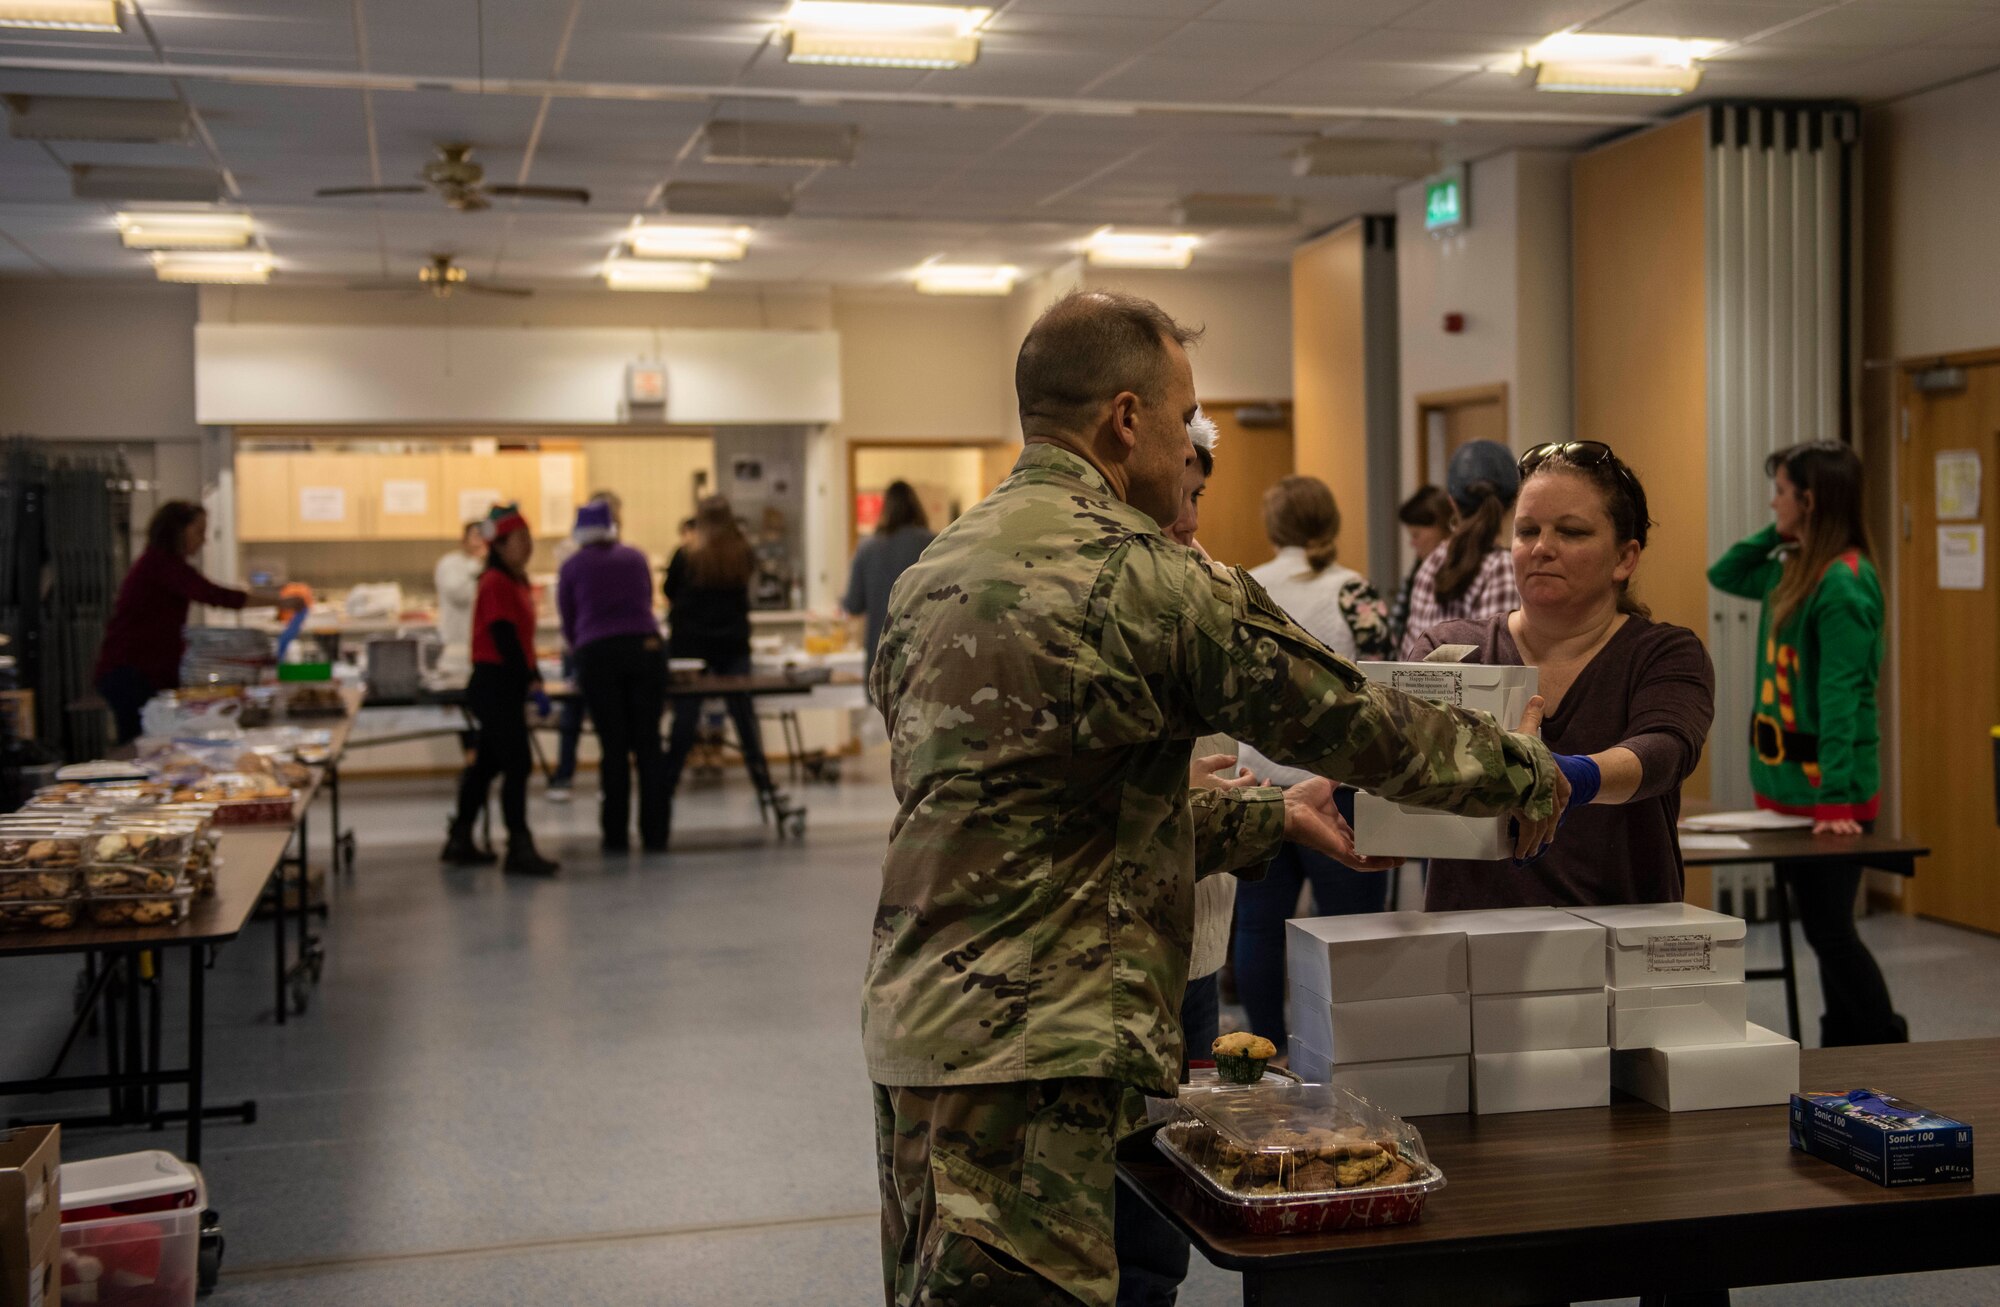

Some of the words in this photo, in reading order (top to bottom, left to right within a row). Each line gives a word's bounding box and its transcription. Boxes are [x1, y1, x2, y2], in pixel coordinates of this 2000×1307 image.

[1794, 1110, 1802, 1122] M
[1814, 1107, 1832, 1122] Sonic
[1833, 1115, 1846, 1128] 100
[1888, 1134, 1914, 1144] Sonic
[1917, 1132, 1935, 1142] 100
[1958, 1131, 1968, 1142] M
